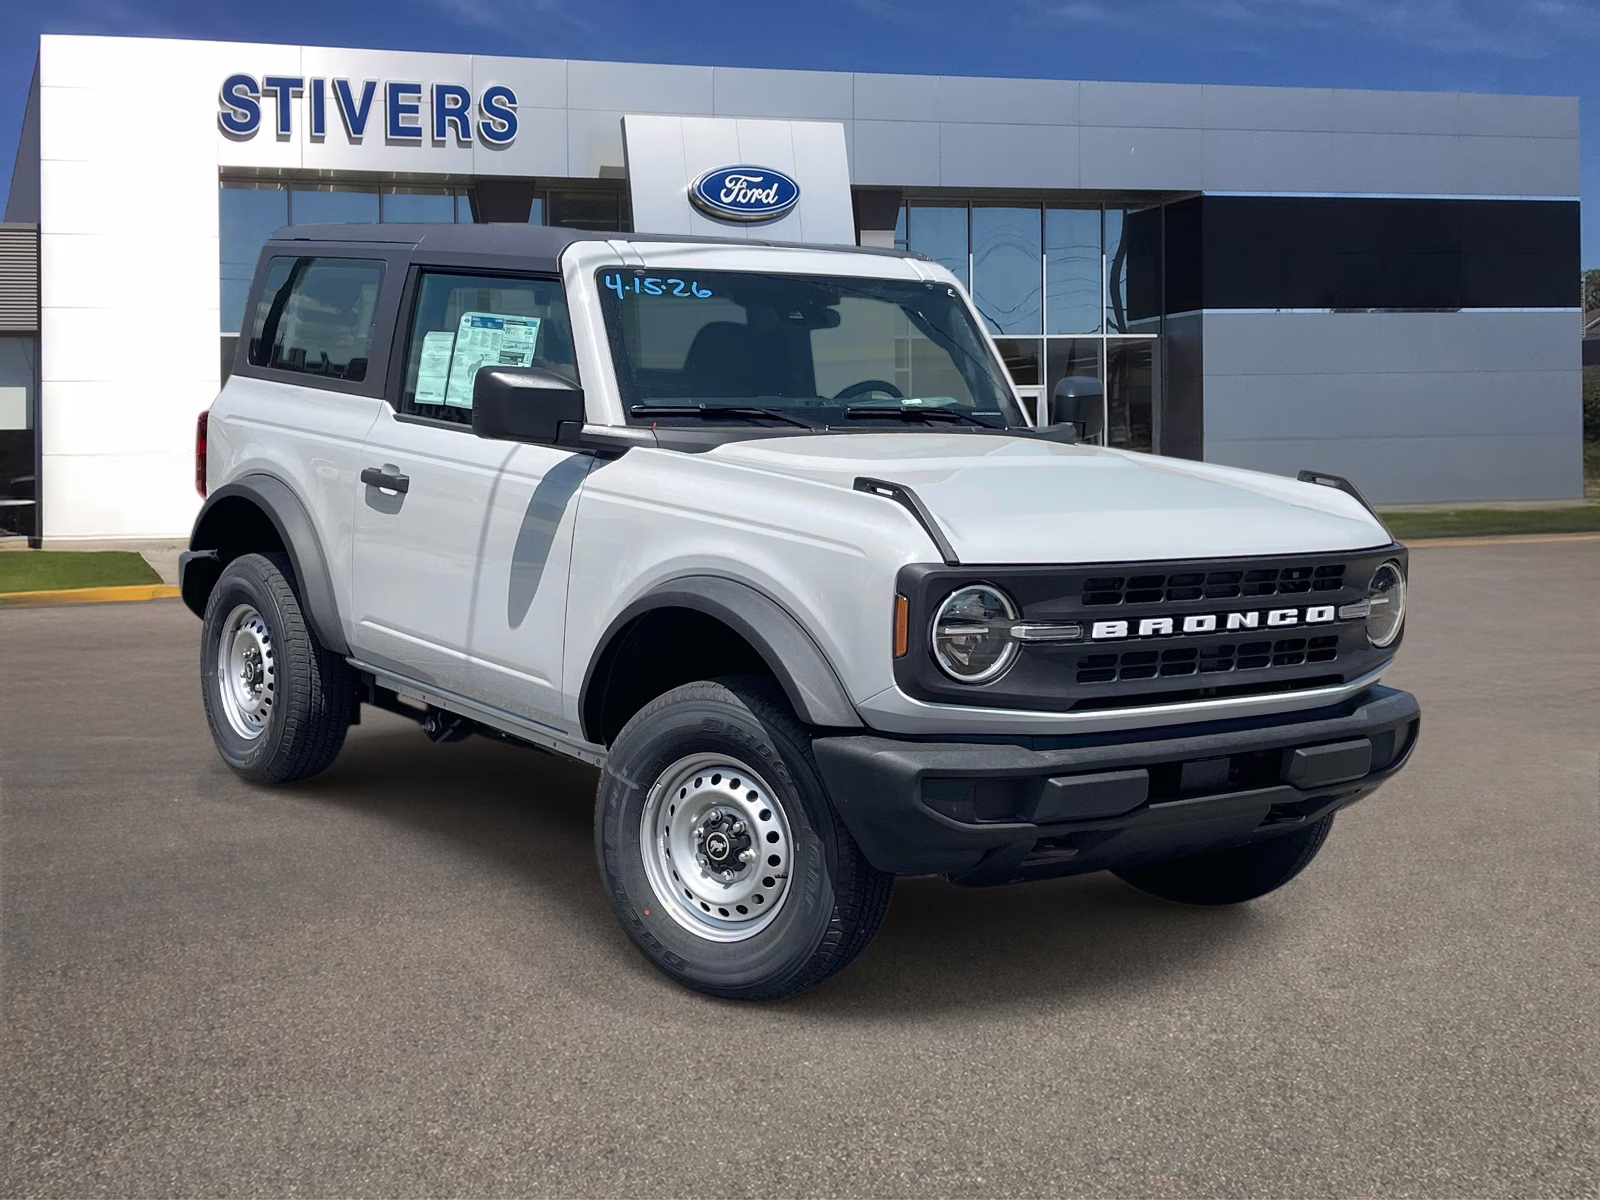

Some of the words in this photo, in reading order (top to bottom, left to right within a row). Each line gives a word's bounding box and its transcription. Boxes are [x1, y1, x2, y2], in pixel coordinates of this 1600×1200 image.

[218, 72, 519, 149] STIVERS
[720, 174, 779, 204] Ford
[1092, 605, 1335, 639] BRONCO
